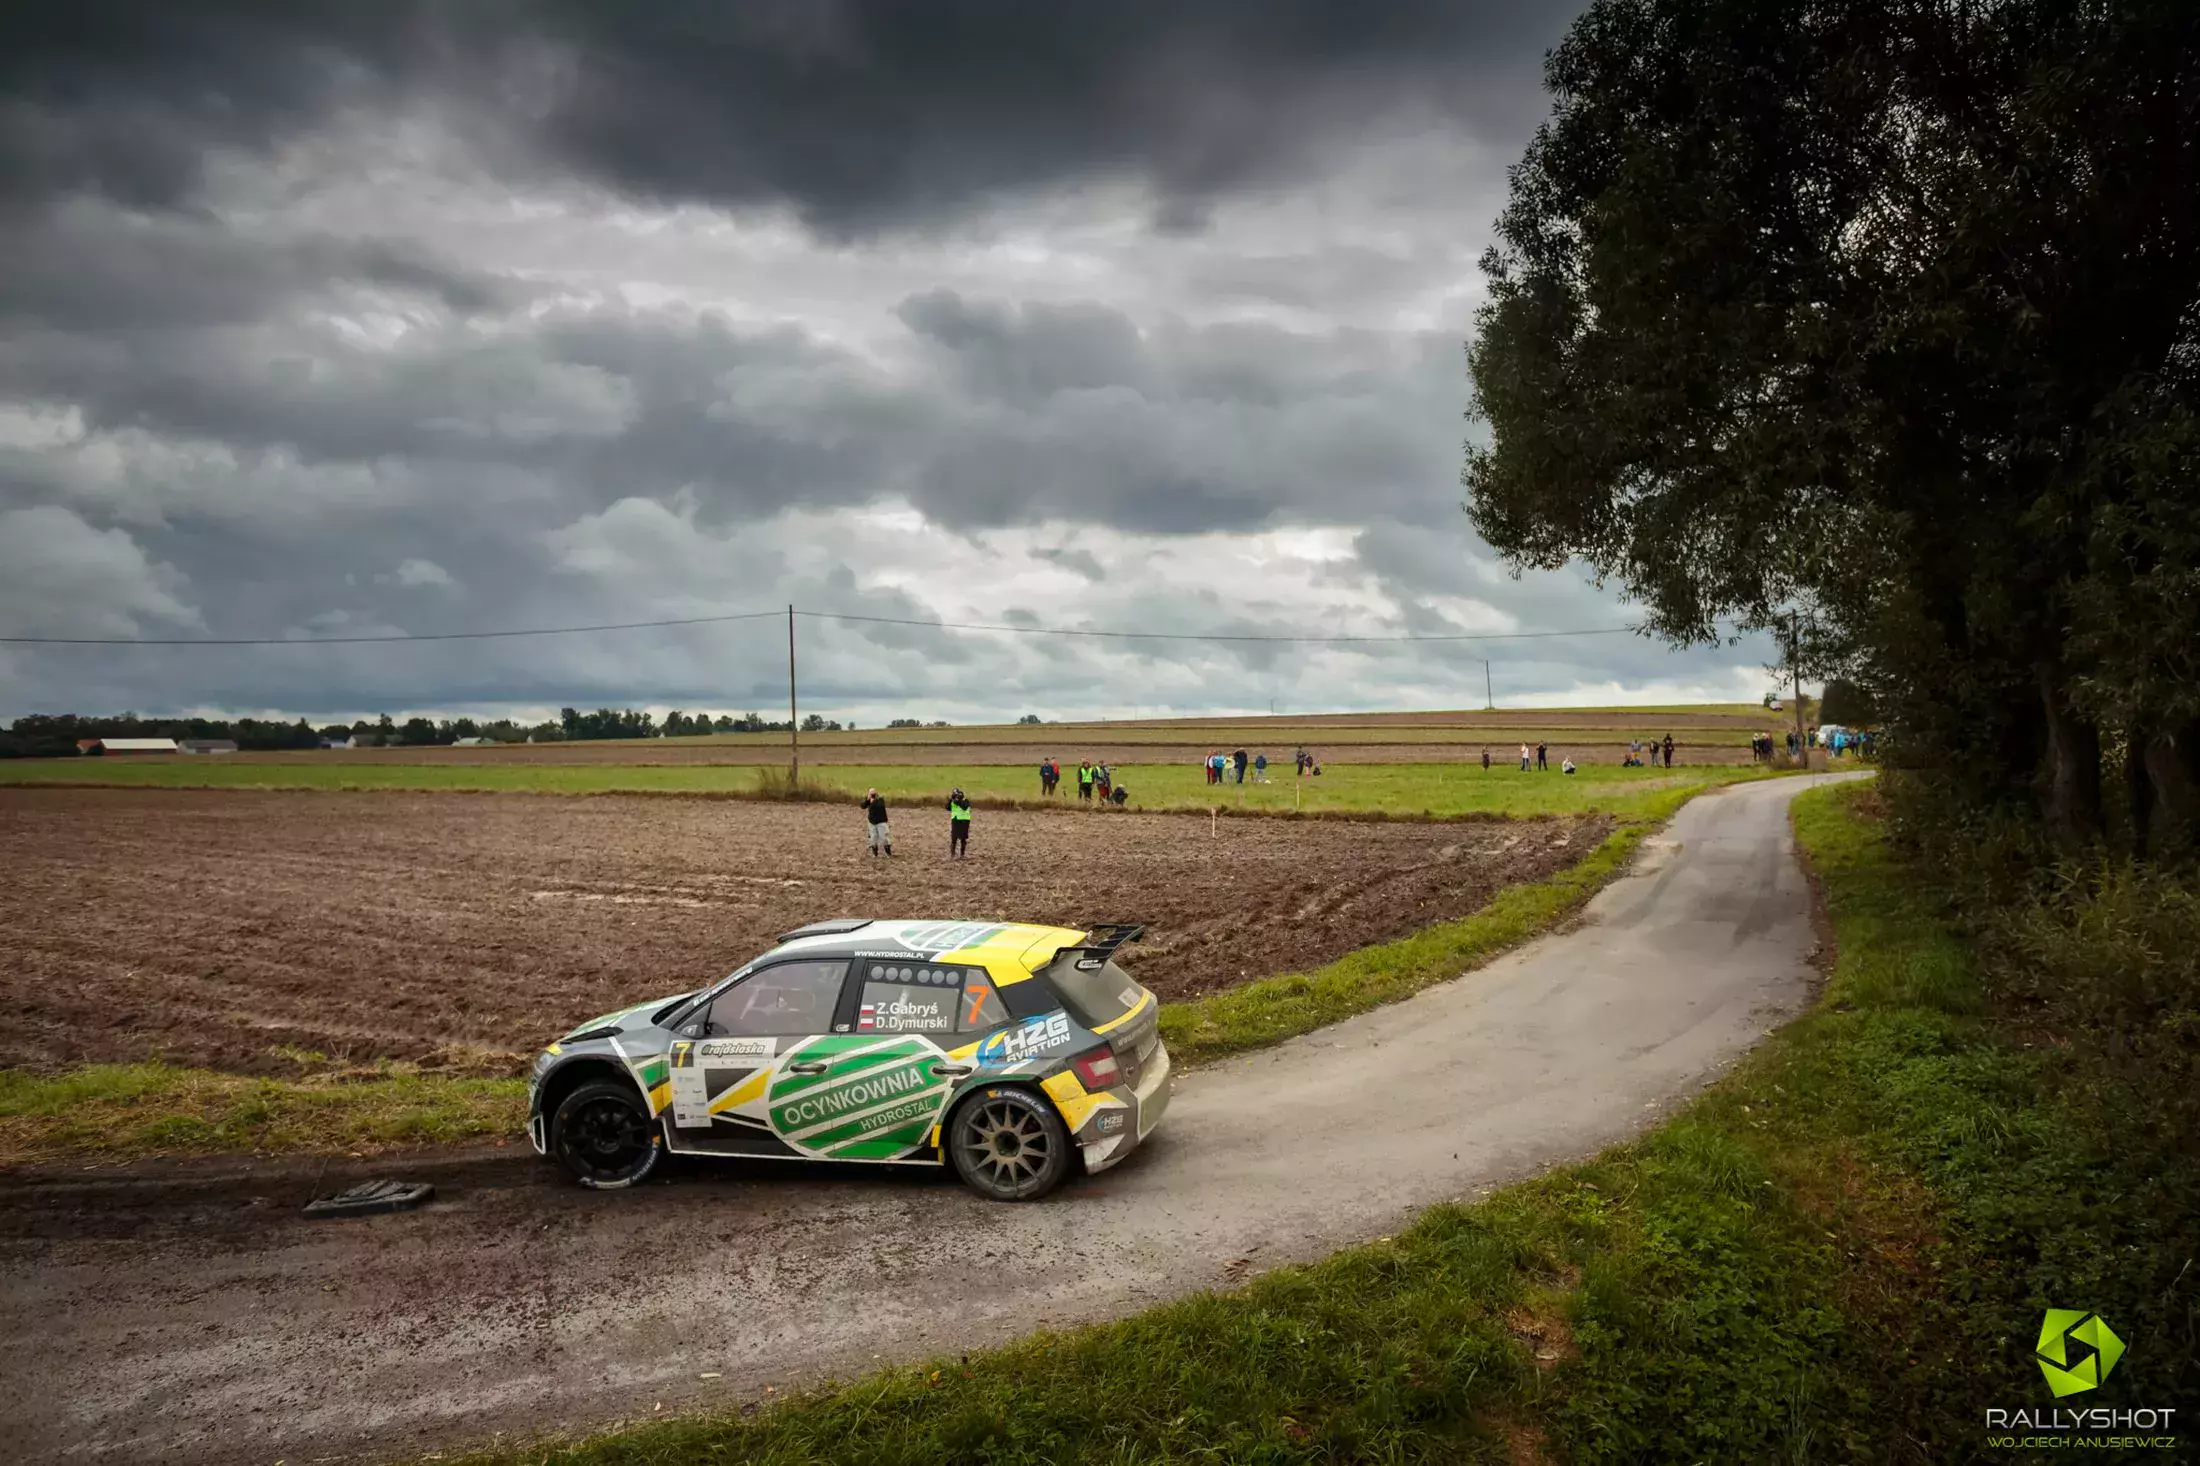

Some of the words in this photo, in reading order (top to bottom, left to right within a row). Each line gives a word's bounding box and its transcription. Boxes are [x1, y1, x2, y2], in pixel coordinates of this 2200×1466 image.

[854, 950, 925, 959] WWW.HYDROSTAL.PL
[876, 1002, 938, 1018] Z.Gabryś
[965, 985, 989, 1024] 7
[876, 1016, 947, 1031] D.Dymurski
[1003, 1012, 1070, 1055] HZG
[676, 1043, 691, 1068] 7
[1006, 1033, 1071, 1062] AVIATION
[784, 1067, 924, 1124] OCYNKOWNIA
[1004, 1091, 1046, 1112] MICHELIN
[860, 1100, 932, 1131] HYDROSTAL
